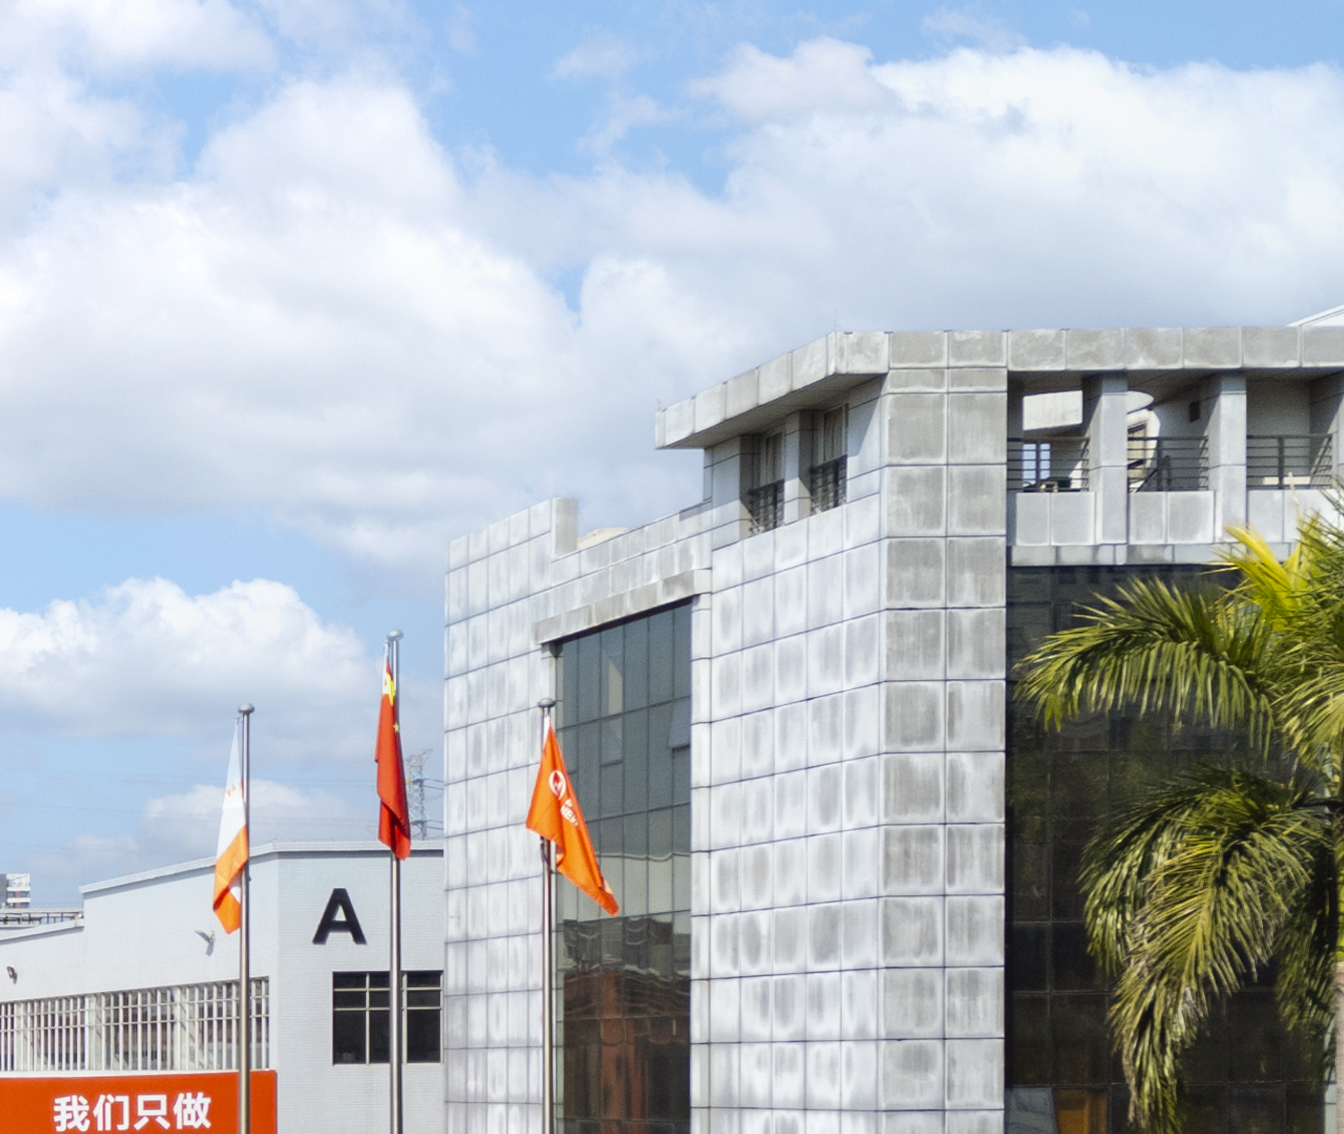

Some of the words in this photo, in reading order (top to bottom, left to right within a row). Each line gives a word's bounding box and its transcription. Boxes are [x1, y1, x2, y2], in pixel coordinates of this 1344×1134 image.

[313, 887, 366, 944] A
[52, 1091, 212, 1133] 我们只做
